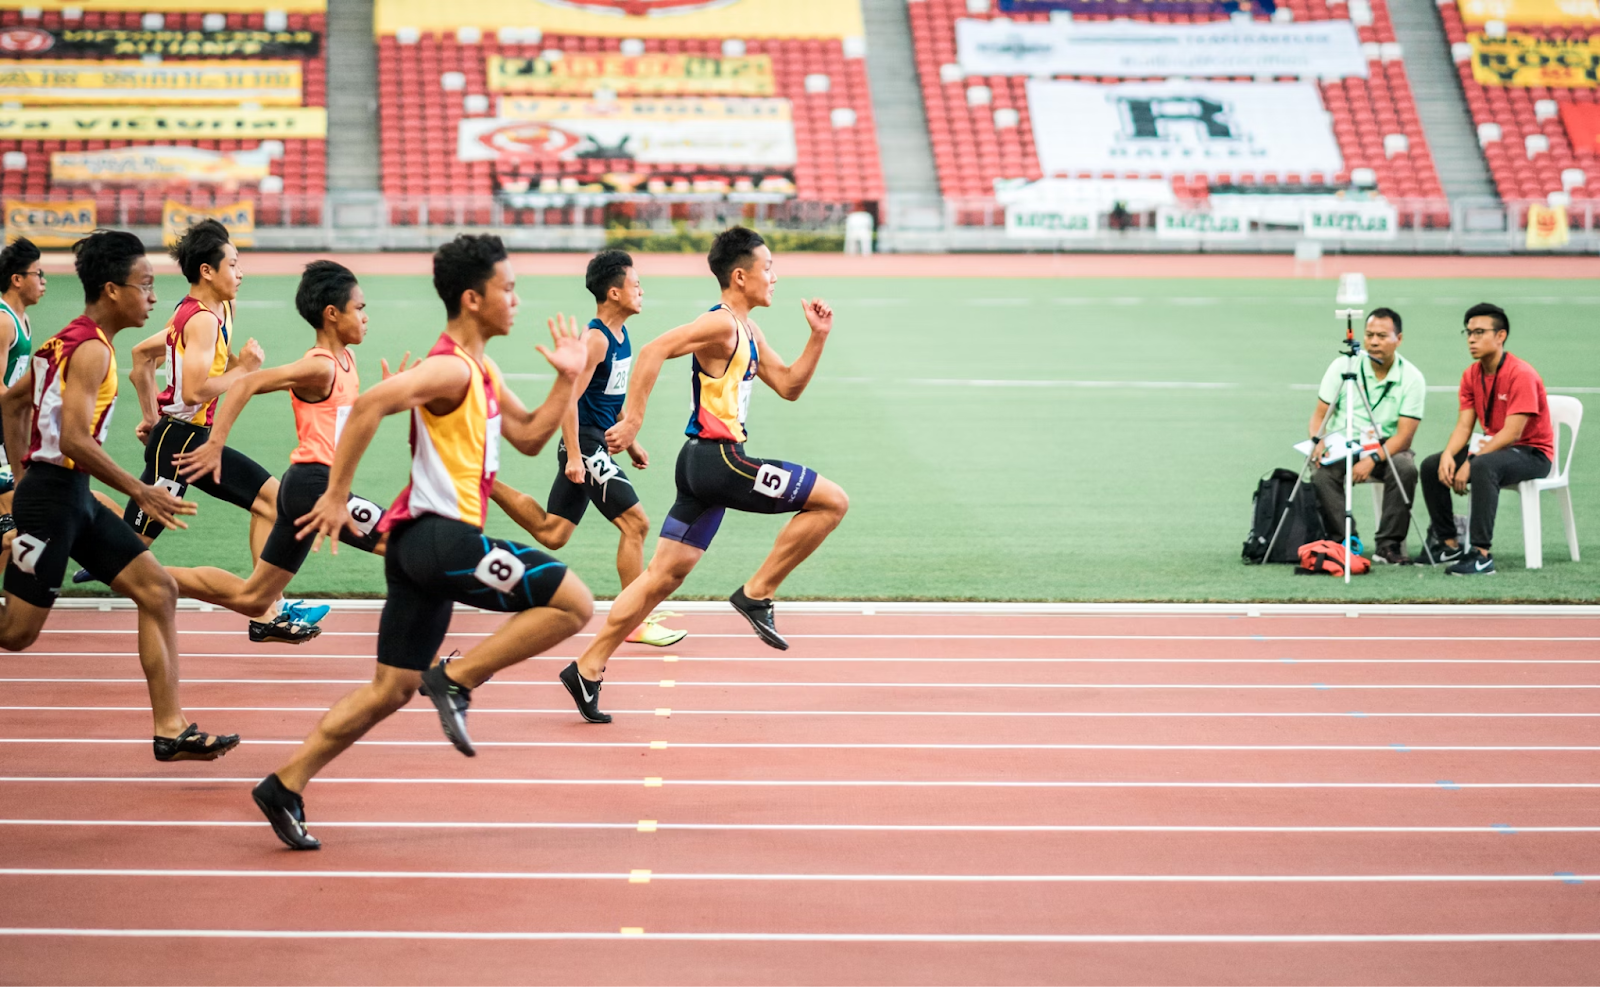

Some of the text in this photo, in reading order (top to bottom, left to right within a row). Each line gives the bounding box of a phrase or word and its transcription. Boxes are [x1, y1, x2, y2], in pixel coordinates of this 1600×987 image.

[10, 207, 93, 227] CEDAR
[593, 459, 611, 477] 2
[761, 471, 781, 491] 5
[351, 505, 371, 523] 6
[18, 539, 36, 563] 7
[489, 558, 512, 582] 8
